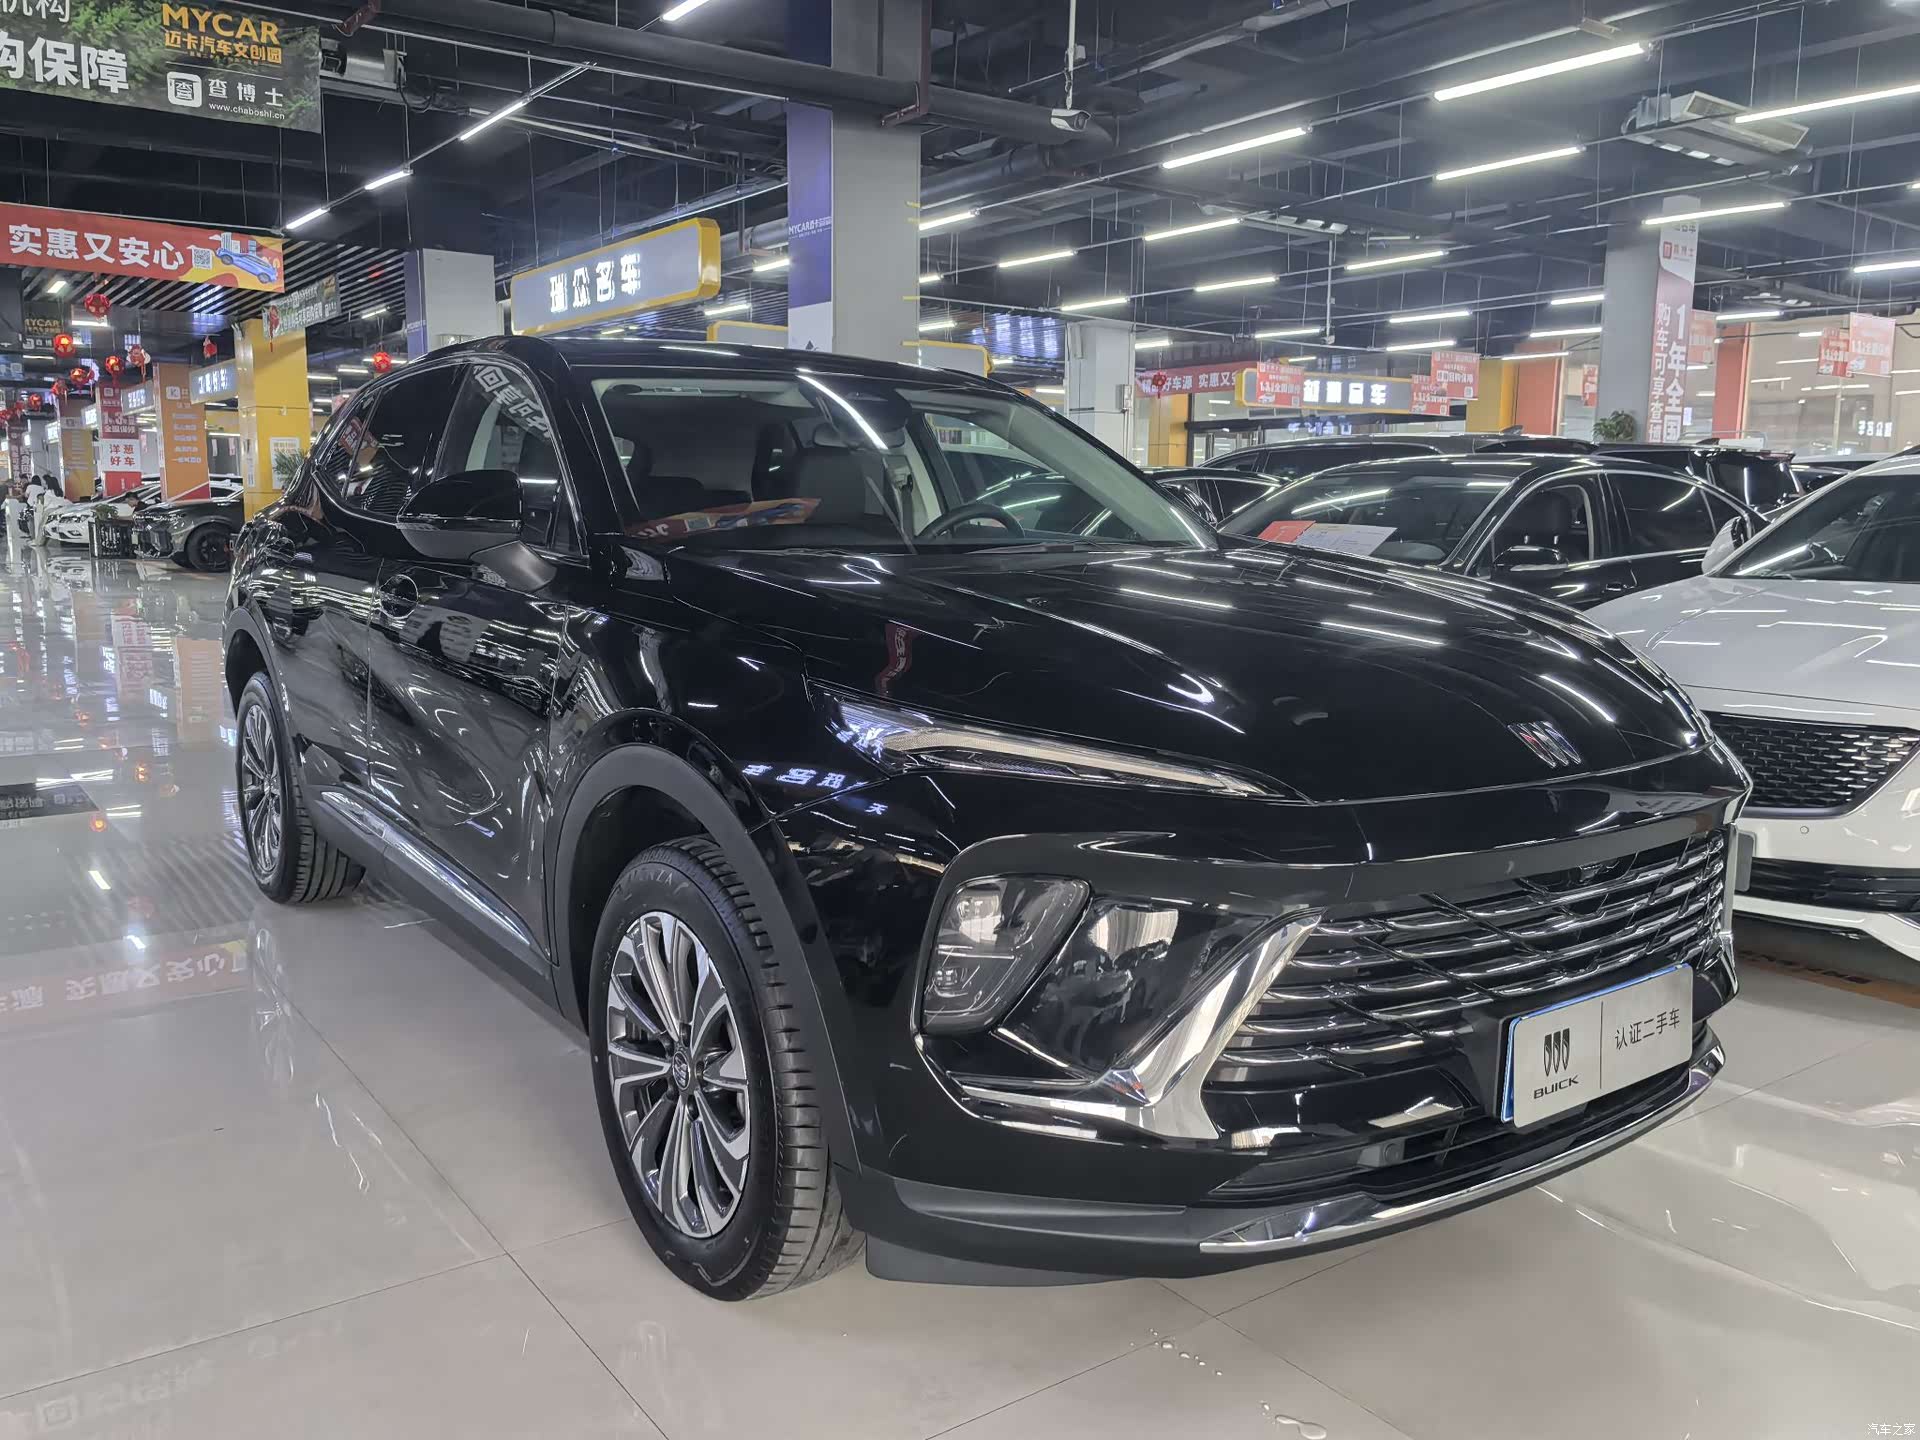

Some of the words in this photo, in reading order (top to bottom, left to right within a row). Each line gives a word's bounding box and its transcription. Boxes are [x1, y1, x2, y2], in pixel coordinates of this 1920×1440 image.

[162, 3, 280, 45] MYCAR
[164, 30, 282, 64] 迈卡汽车文创园
[208, 79, 284, 107] 查博士
[208, 102, 285, 120] www.chaboshi.cn
[8, 224, 184, 271] 实惠又安心
[110, 456, 135, 466] 好车
[1615, 1008, 1681, 1050] 认证二手车
[1533, 1075, 1579, 1100] BUICK
